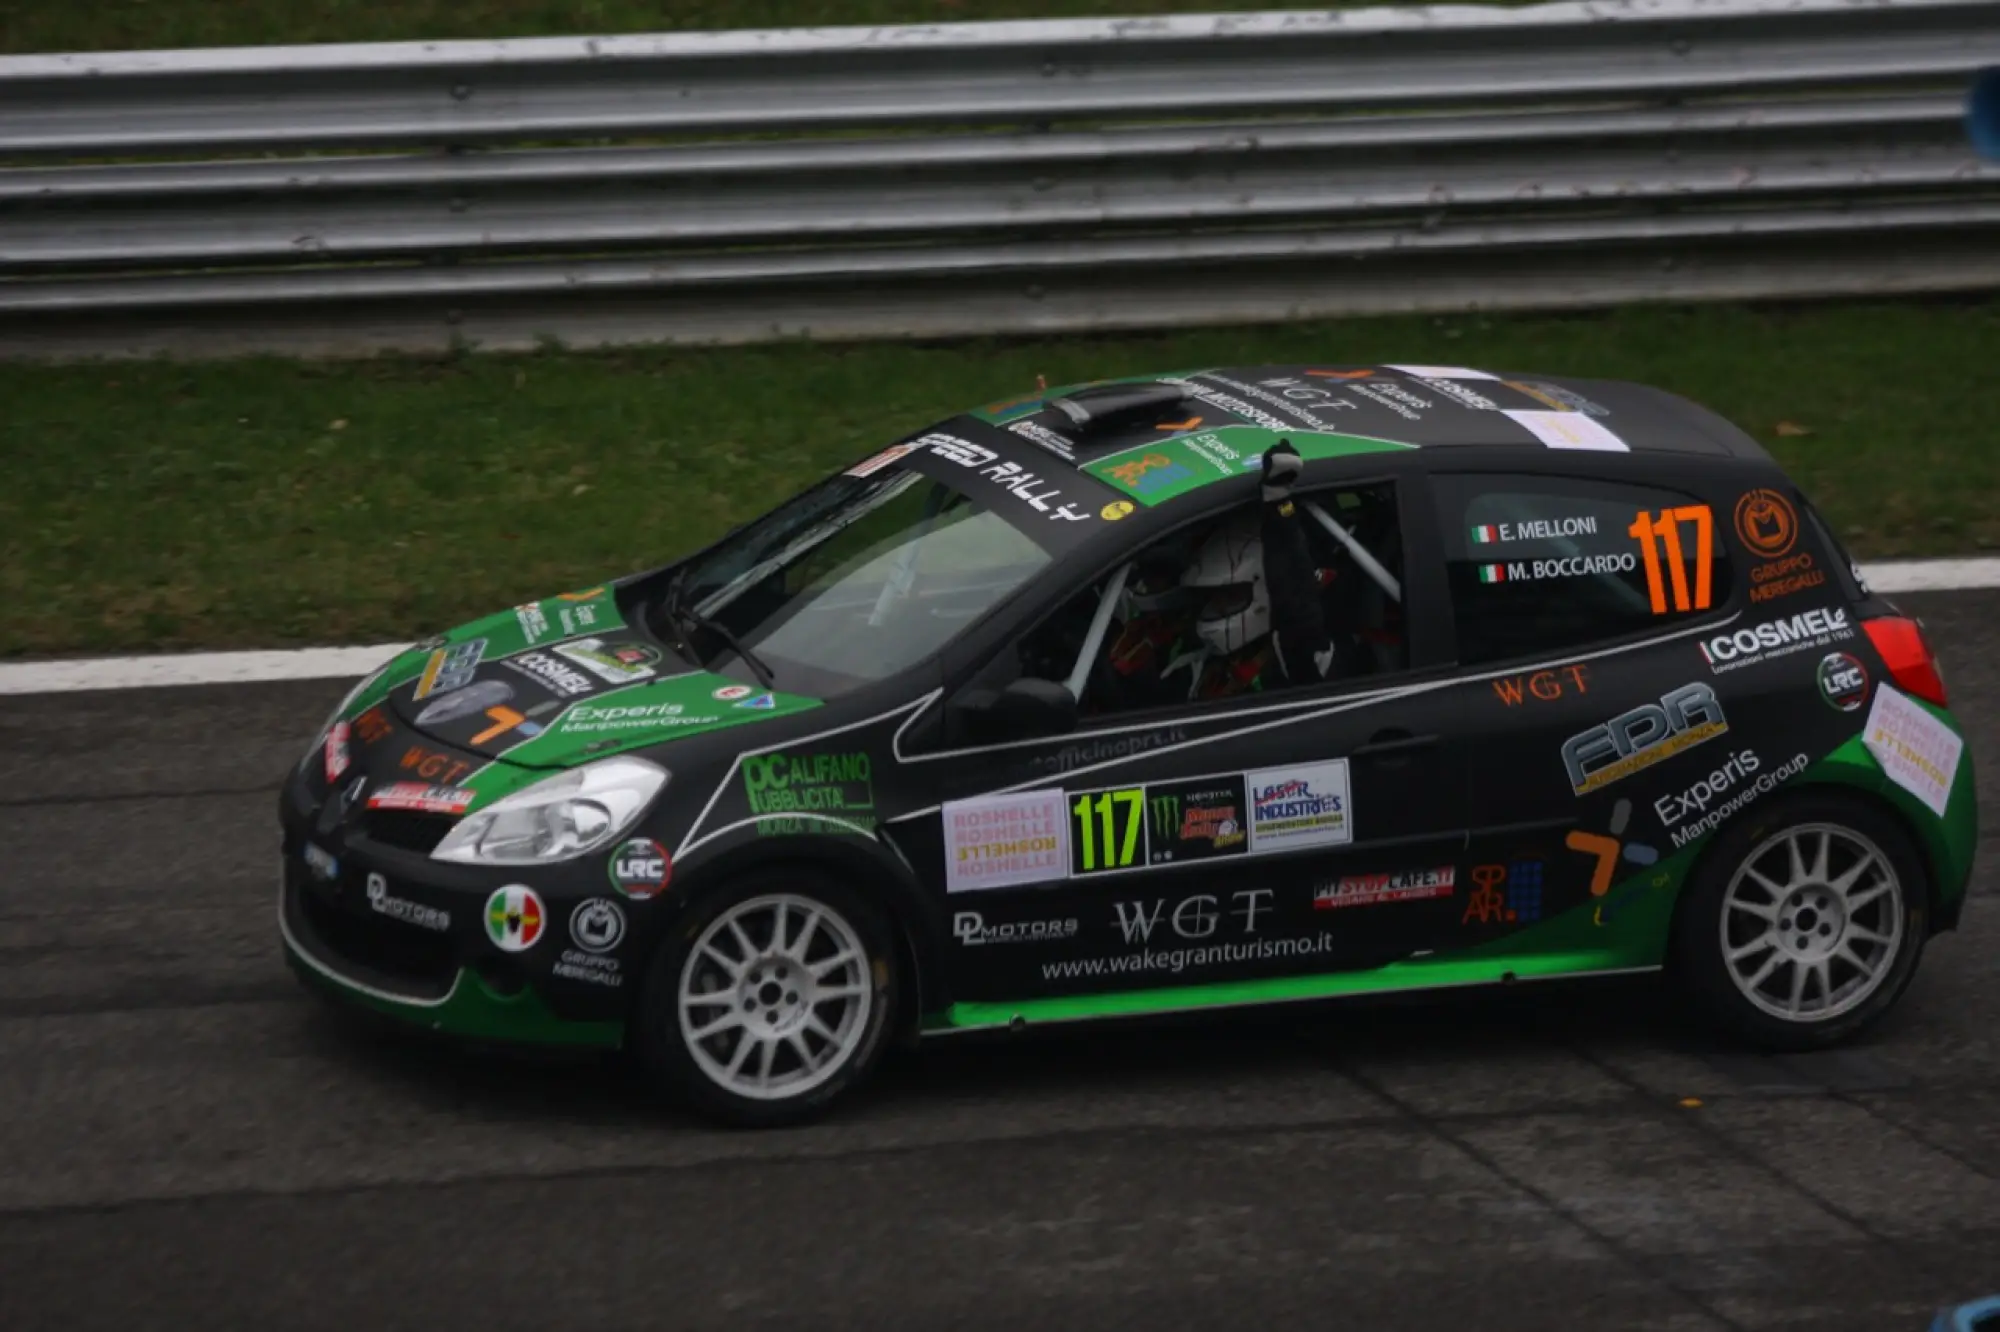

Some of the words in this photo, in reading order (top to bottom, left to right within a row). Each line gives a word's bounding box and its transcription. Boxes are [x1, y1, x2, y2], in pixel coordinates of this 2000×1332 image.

[979, 461, 1091, 521] RALLY
[1499, 524, 1515, 541] E.
[1518, 516, 1597, 540] MELLONI
[1507, 563, 1530, 581] M.
[1532, 552, 1636, 579] BOCCARDO
[1628, 505, 1713, 616] 117
[1751, 553, 1812, 582] GRUPPO
[1749, 570, 1825, 602] MEREGALLI
[1710, 606, 1848, 660] COSMEL
[1492, 664, 1590, 706] WGT
[1823, 667, 1864, 695] LRC
[568, 703, 684, 721] Experis
[401, 745, 469, 784] WGT
[1652, 749, 1761, 826] Experis
[1670, 752, 1809, 849] ManpowerGroup
[955, 803, 1054, 827] ROSHELLE
[1072, 789, 1144, 871] 117
[956, 820, 1055, 844] ROSHELLE
[616, 858, 665, 878] LRC
[957, 853, 1057, 877] ROSHELLE
[1110, 888, 1274, 946] WGT
[561, 948, 620, 972] GRUPPO
[1041, 931, 1333, 981] www.wakegranturismo.it
